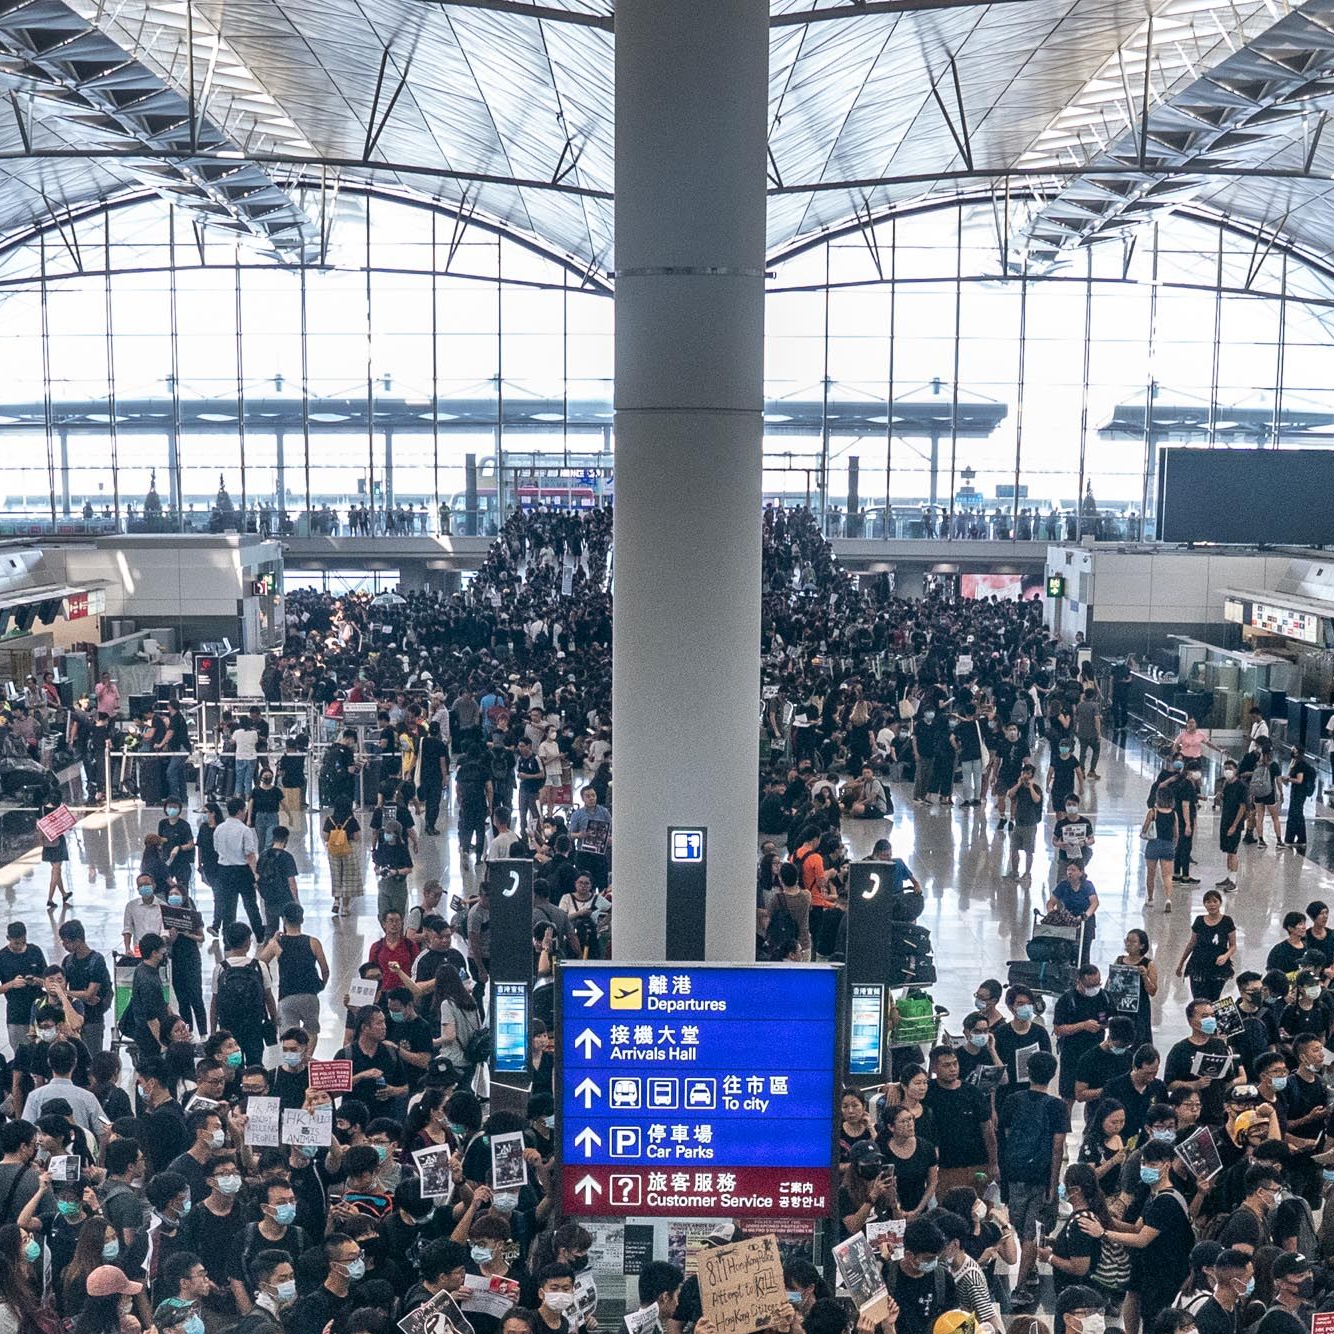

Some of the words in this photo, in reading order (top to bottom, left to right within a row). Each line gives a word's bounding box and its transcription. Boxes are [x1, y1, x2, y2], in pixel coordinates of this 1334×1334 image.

[647, 975, 691, 995] 離港
[647, 997, 726, 1013] Departures
[610, 1025, 699, 1045] 接機大堂
[610, 1046, 665, 1060] Arrivals
[669, 1046, 696, 1060] Hall
[722, 1076, 789, 1095] 往市區
[722, 1097, 740, 1110] To
[742, 1096, 769, 1113] city
[286, 1113, 307, 1125] HK
[286, 1133, 322, 1144] ANIMAL
[647, 1124, 713, 1143] 停車場
[647, 1146, 673, 1159] Car
[676, 1146, 714, 1159] Parks
[648, 1173, 737, 1192] 旅客服務
[779, 1182, 814, 1194] ご案内
[647, 1193, 717, 1208] Customer
[721, 1194, 773, 1208] Service
[779, 1196, 825, 1208] 공항안내
[712, 1284, 744, 1307] Attempt
[746, 1284, 754, 1297] to
[755, 1272, 778, 1298] KILL
